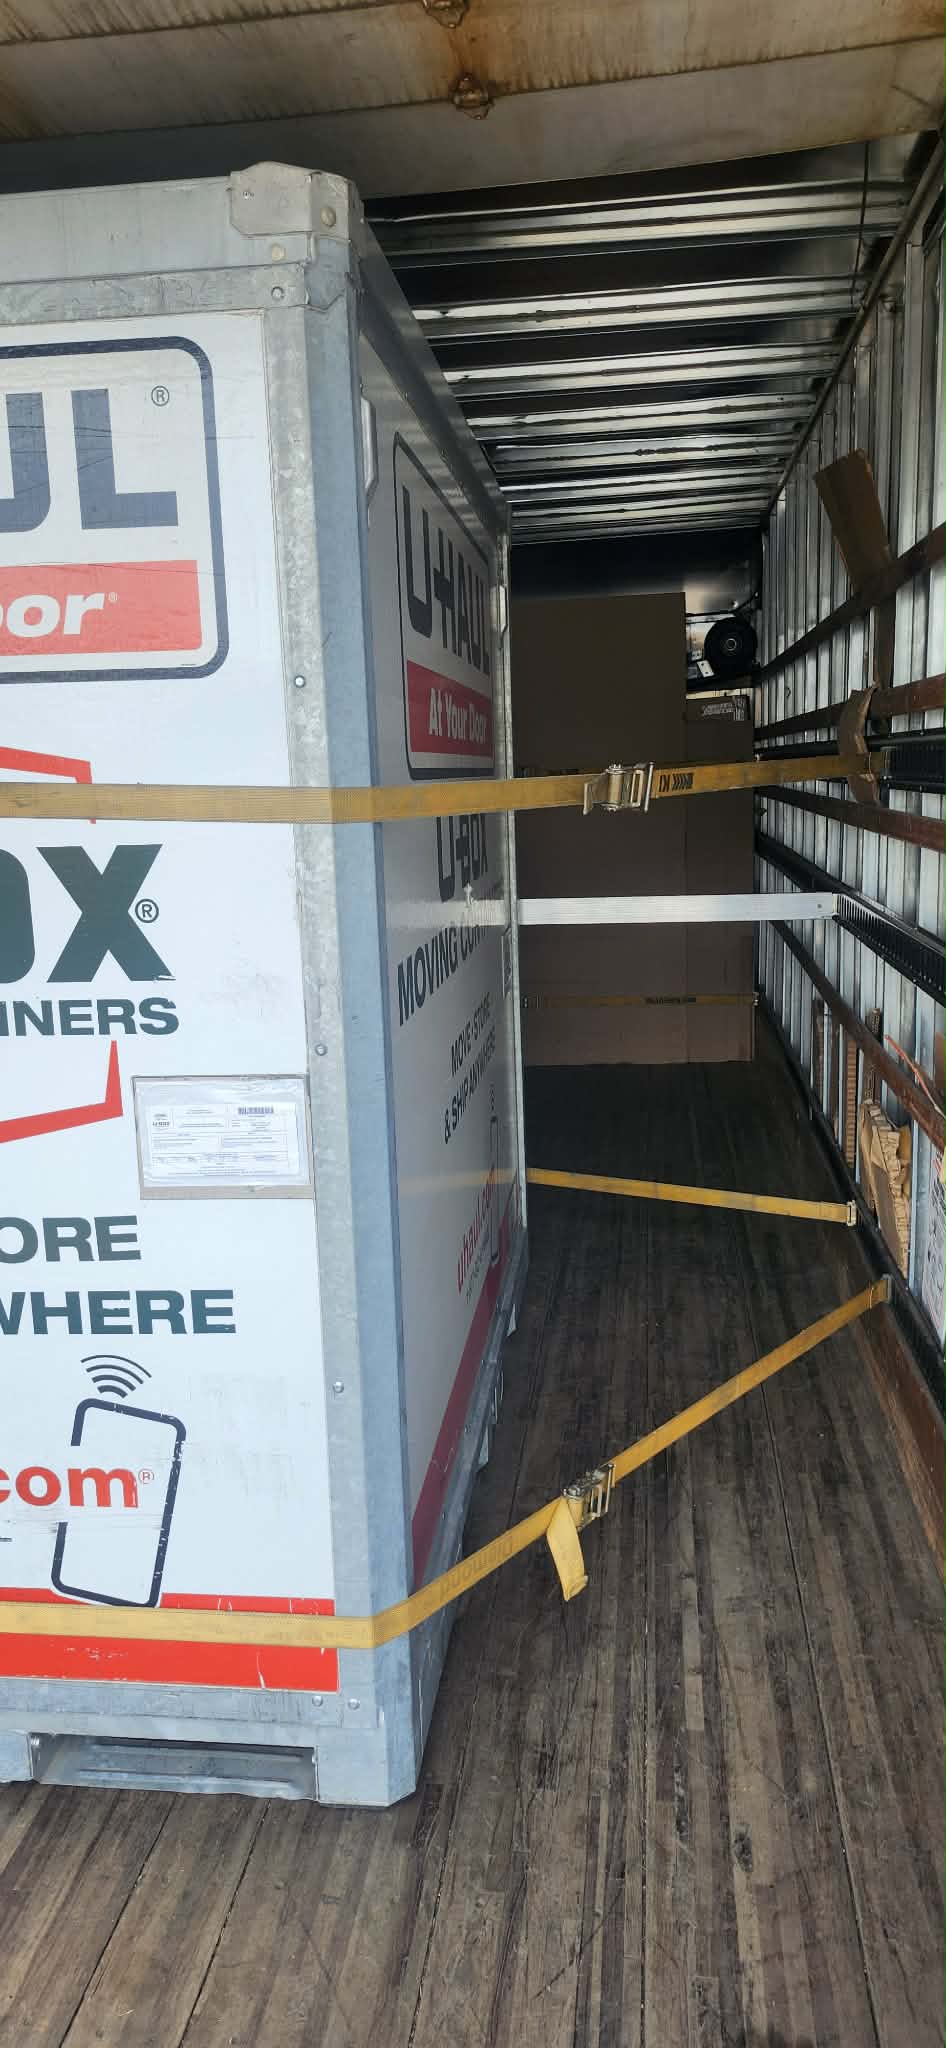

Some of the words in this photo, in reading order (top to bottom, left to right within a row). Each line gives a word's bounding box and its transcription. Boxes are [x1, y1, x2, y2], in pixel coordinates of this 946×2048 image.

[428, 687, 444, 737] At
[446, 693, 467, 741] Your
[397, 926, 458, 1027] MOVING
[0, 1215, 142, 1264] ORE
